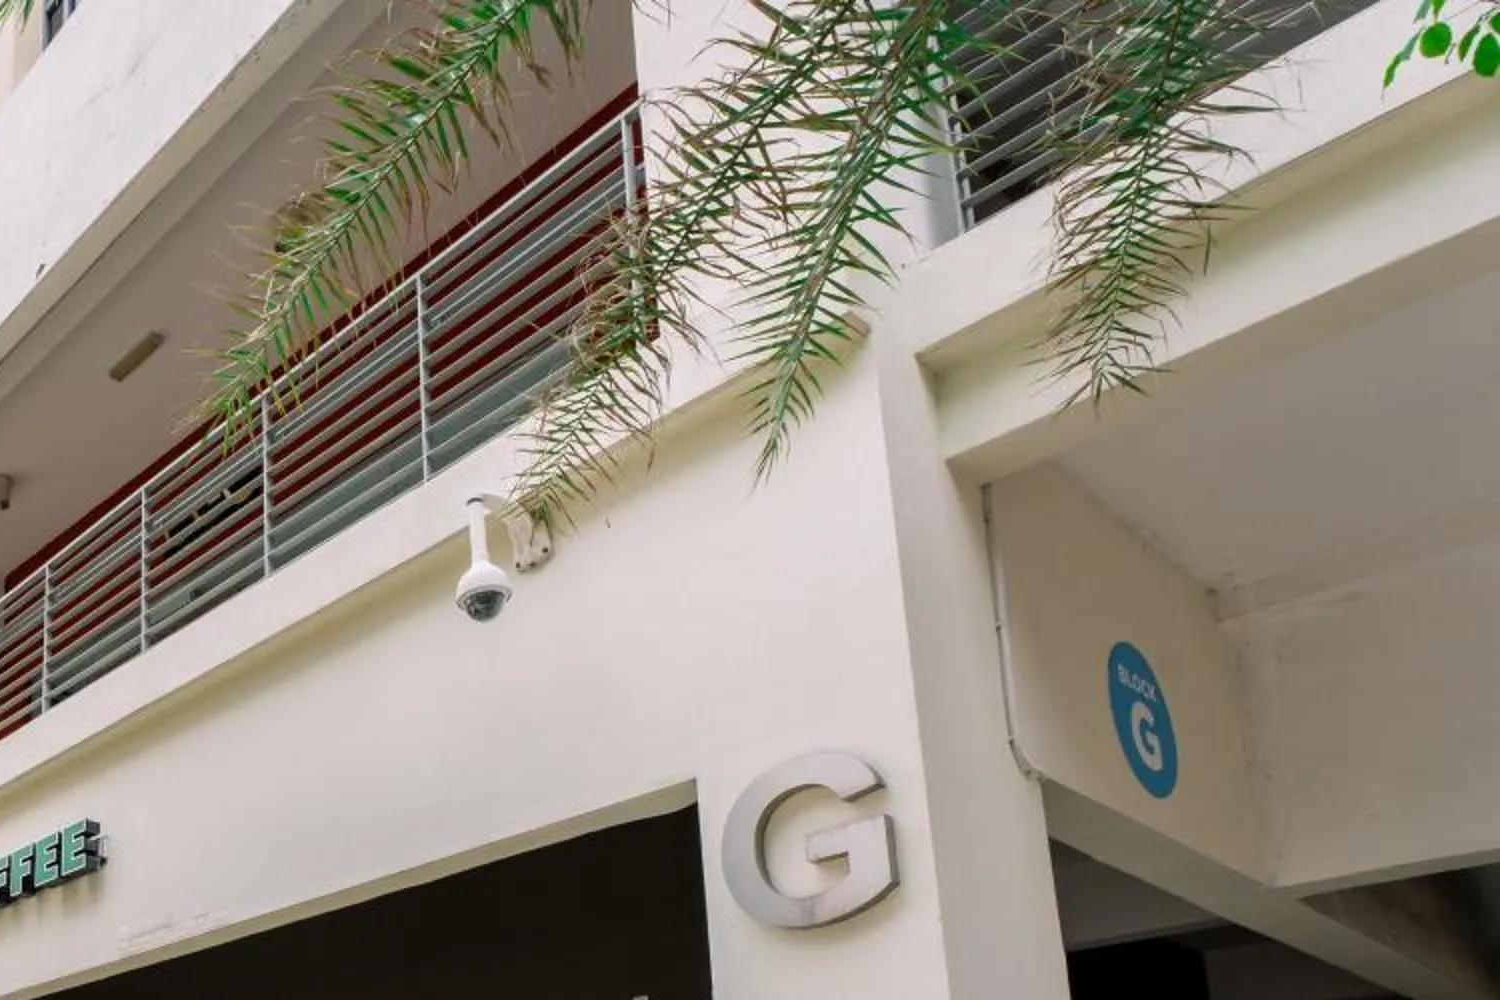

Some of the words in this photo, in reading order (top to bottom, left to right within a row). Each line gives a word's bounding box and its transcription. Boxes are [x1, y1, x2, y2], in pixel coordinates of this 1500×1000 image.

[1117, 662, 1157, 701] BLOCK
[1131, 701, 1163, 771] G
[721, 751, 900, 930] G
